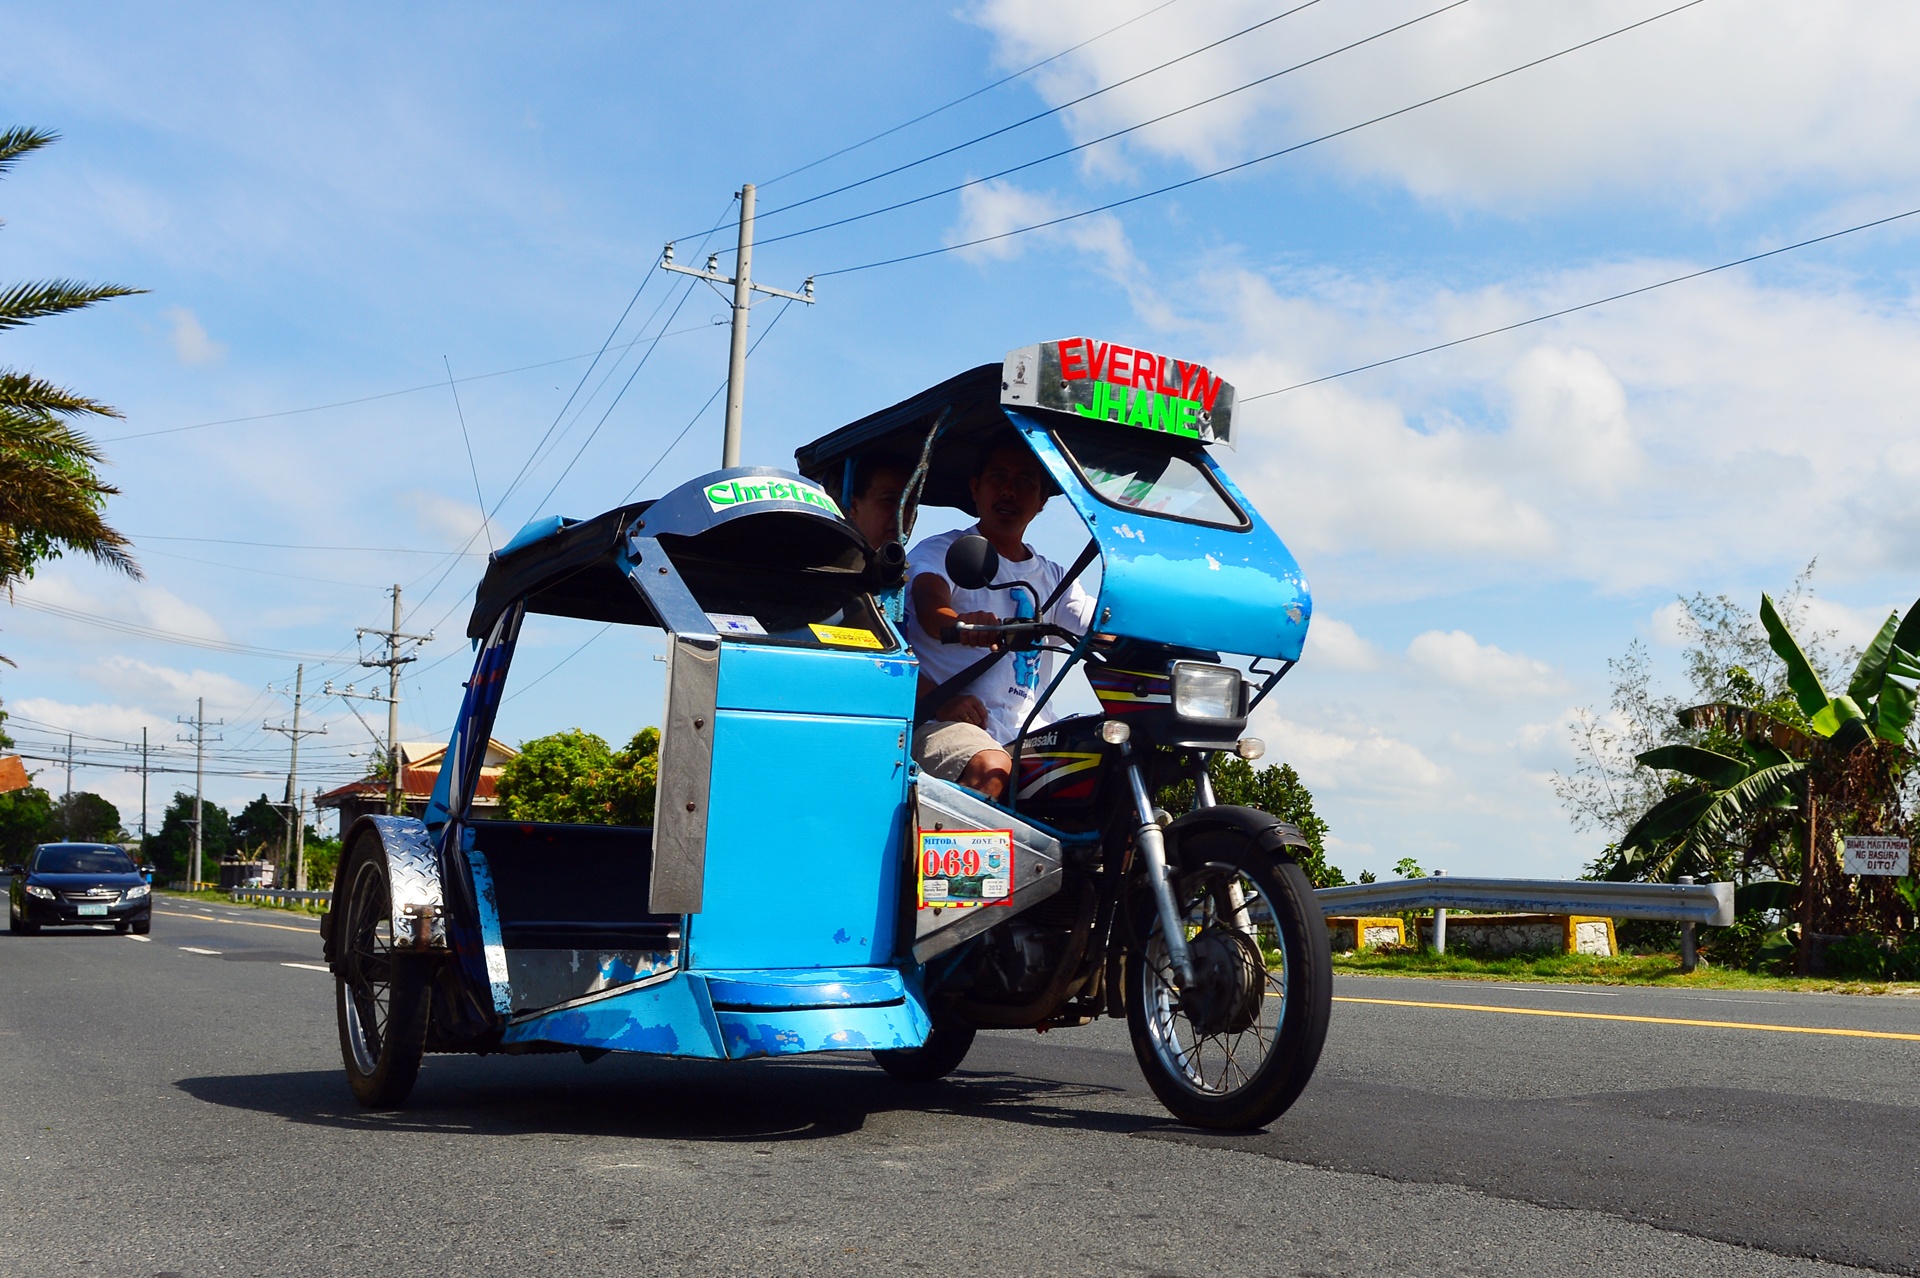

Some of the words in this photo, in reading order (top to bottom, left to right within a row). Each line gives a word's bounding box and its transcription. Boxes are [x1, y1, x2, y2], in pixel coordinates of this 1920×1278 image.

[1058, 338, 1222, 412] EVERLYN
[1075, 380, 1201, 439] JHANE
[707, 481, 842, 517] Christian
[1021, 731, 1058, 749] awasaki
[1855, 851, 1866, 859] NG
[1868, 851, 1900, 860] BASURA
[1867, 840, 1908, 850] MAGTAMBAK
[923, 849, 980, 877] 069
[1867, 861, 1896, 870] DITO!
